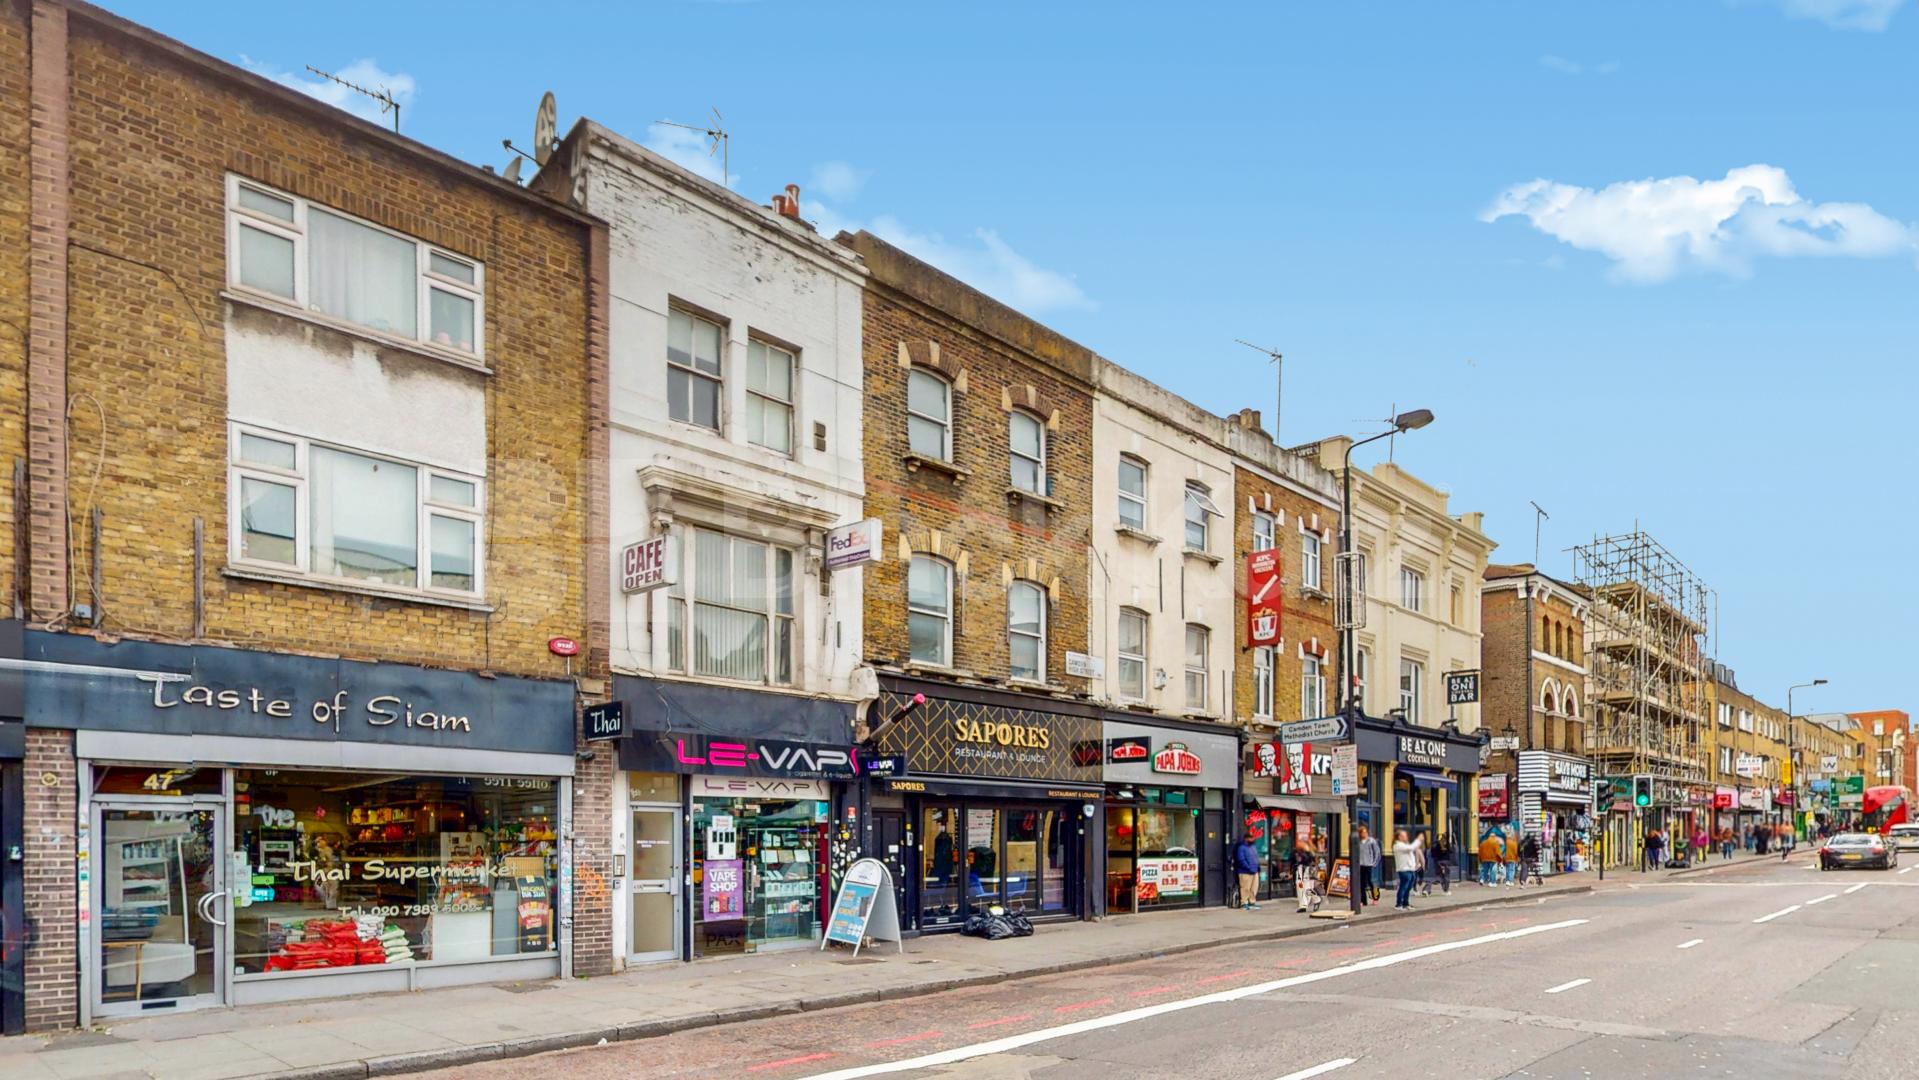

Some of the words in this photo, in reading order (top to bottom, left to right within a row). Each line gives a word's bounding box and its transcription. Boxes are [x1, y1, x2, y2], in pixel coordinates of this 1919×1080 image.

[625, 540, 663, 576] CAFE
[625, 569, 662, 589] OPEN
[1451, 682, 1475, 691] ONE
[136, 672, 292, 717] Taste
[312, 690, 348, 733] of
[366, 695, 471, 733] Siam
[1451, 692, 1475, 702] BAR
[590, 710, 621, 733] Thai
[955, 718, 1050, 749] SAPORES
[1314, 728, 1336, 737] Church
[1401, 736, 1413, 752] BE
[1414, 739, 1426, 754] AT
[1427, 741, 1446, 757] ONE
[955, 748, 1007, 760] RESTAURANT
[1016, 752, 1046, 763] LOUNGE
[1155, 752, 1176, 770] PAPA
[1311, 753, 1333, 775] KF
[144, 773, 174, 790] 47
[891, 781, 925, 791] SAPORES
[285, 860, 351, 881] Thai
[362, 858, 518, 885] Supermarket
[709, 871, 738, 882] VAPE
[710, 881, 738, 893] SHOP
[371, 905, 400, 916] 020
